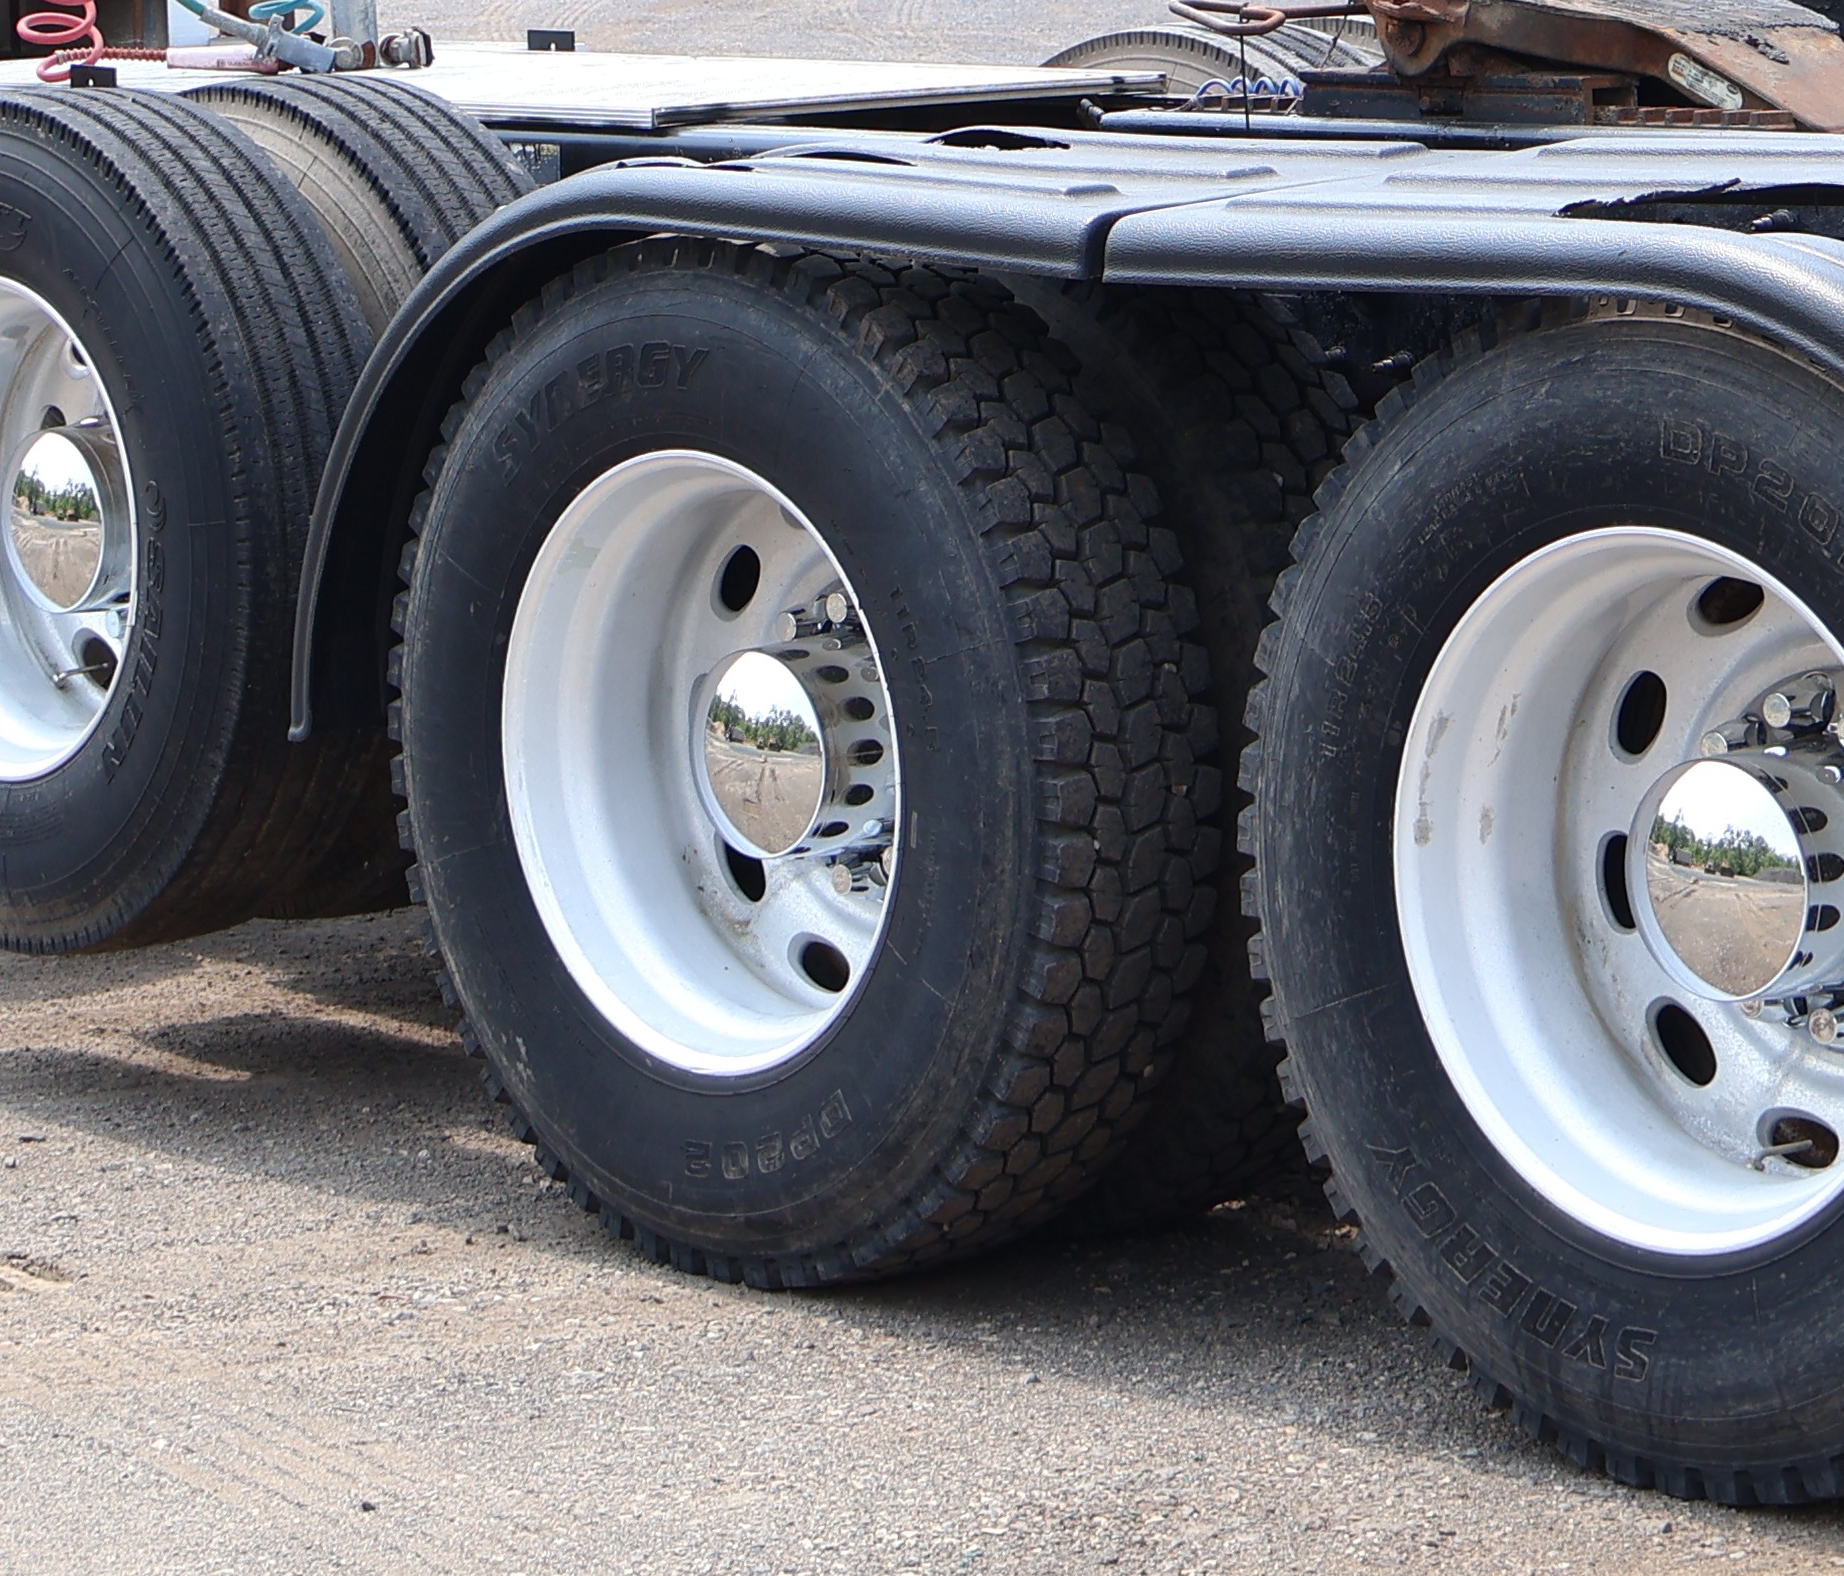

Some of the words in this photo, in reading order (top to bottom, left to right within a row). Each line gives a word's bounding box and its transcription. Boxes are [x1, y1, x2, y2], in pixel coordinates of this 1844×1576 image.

[493, 339, 709, 488] SYNERGY
[102, 536, 166, 787] SAILUN
[683, 1087, 853, 1180] DP202
[1365, 1140, 1659, 1384] SYNERGY
